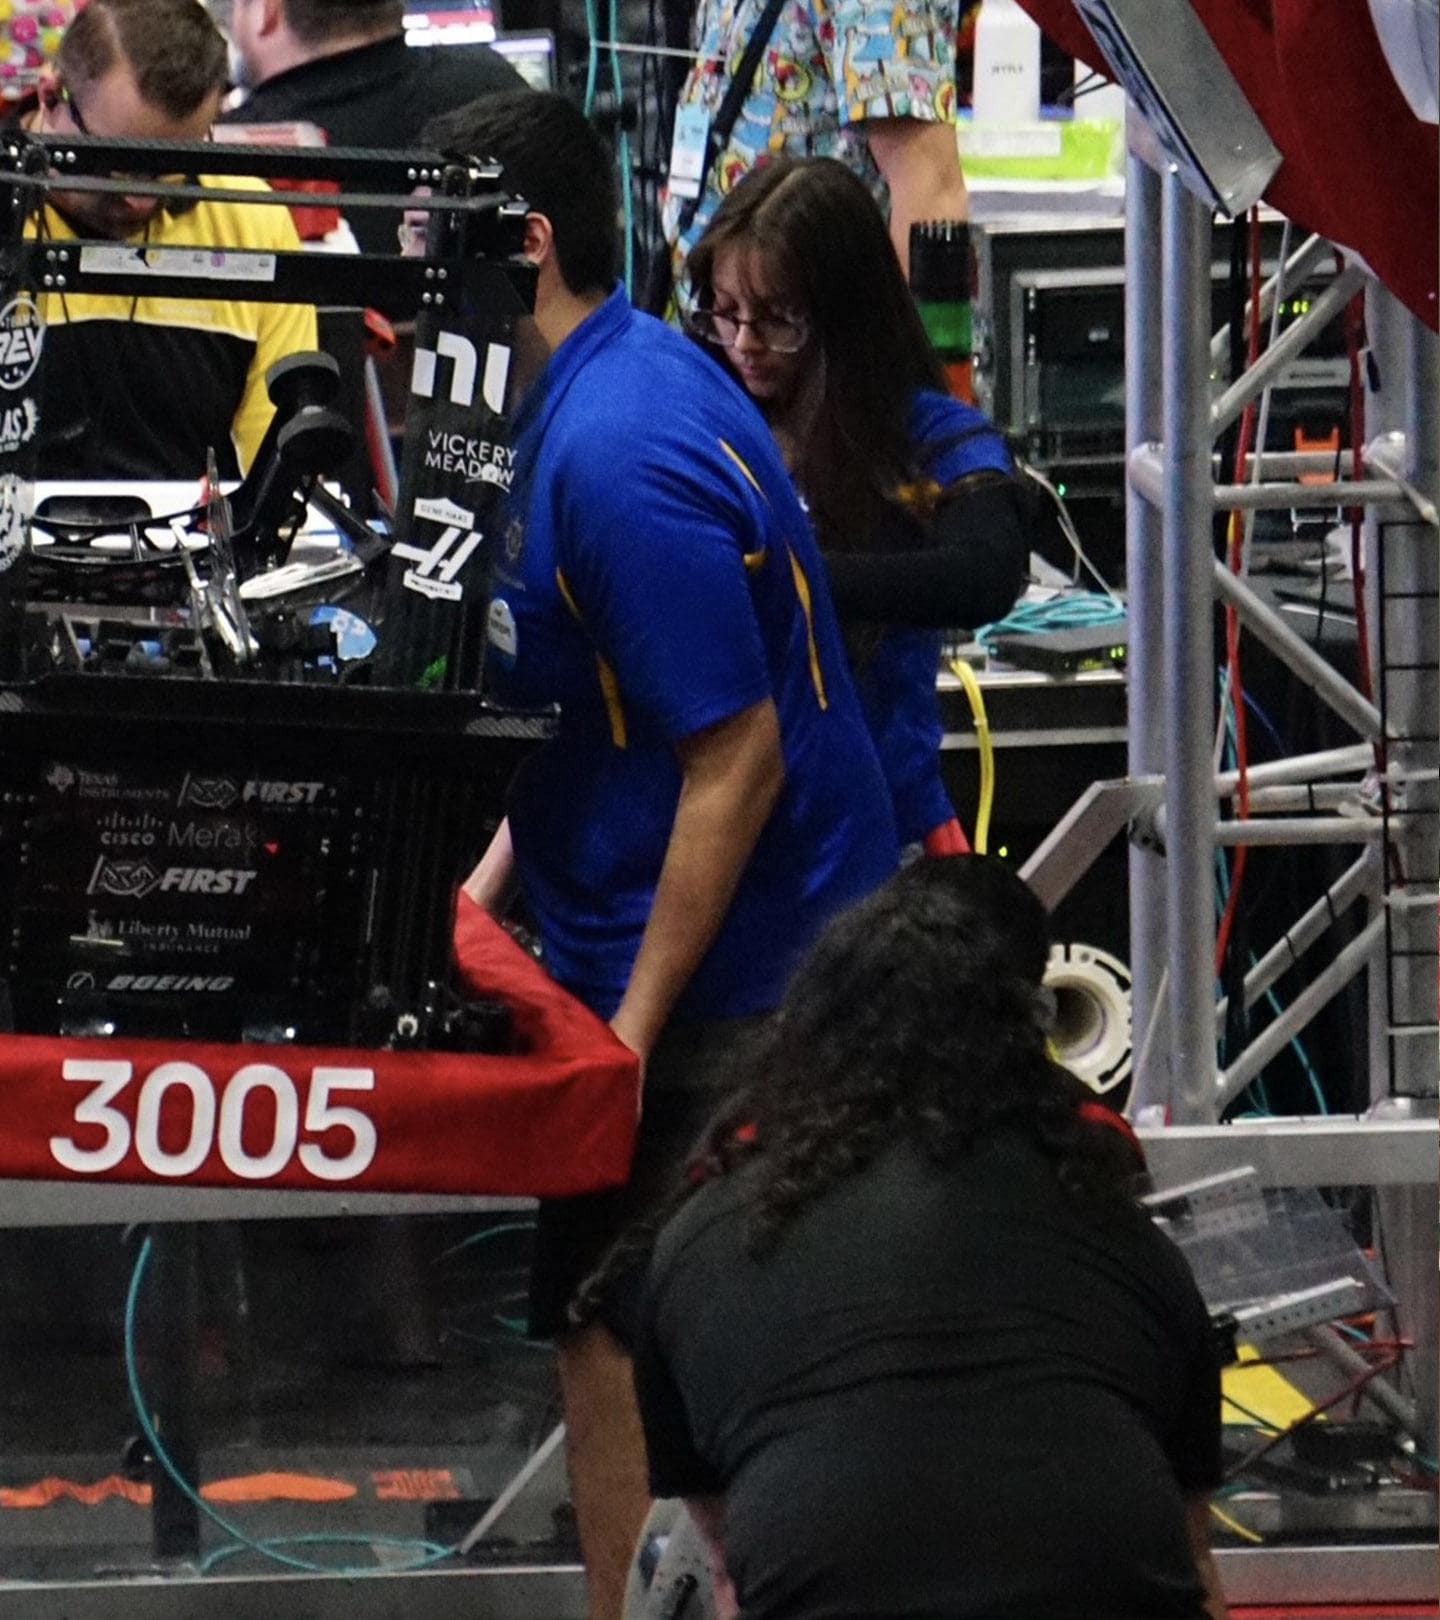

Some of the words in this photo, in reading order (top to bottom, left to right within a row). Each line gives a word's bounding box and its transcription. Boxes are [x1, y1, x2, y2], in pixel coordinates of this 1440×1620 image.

[428, 430, 517, 467] VICKERY
[425, 452, 515, 486] MEADOW
[242, 780, 325, 803] FIRST
[160, 867, 258, 895] FIRST
[118, 919, 179, 938] Liberty
[185, 922, 252, 941] Mutual
[107, 974, 235, 991] BOEING
[49, 1058, 377, 1181] 3005
